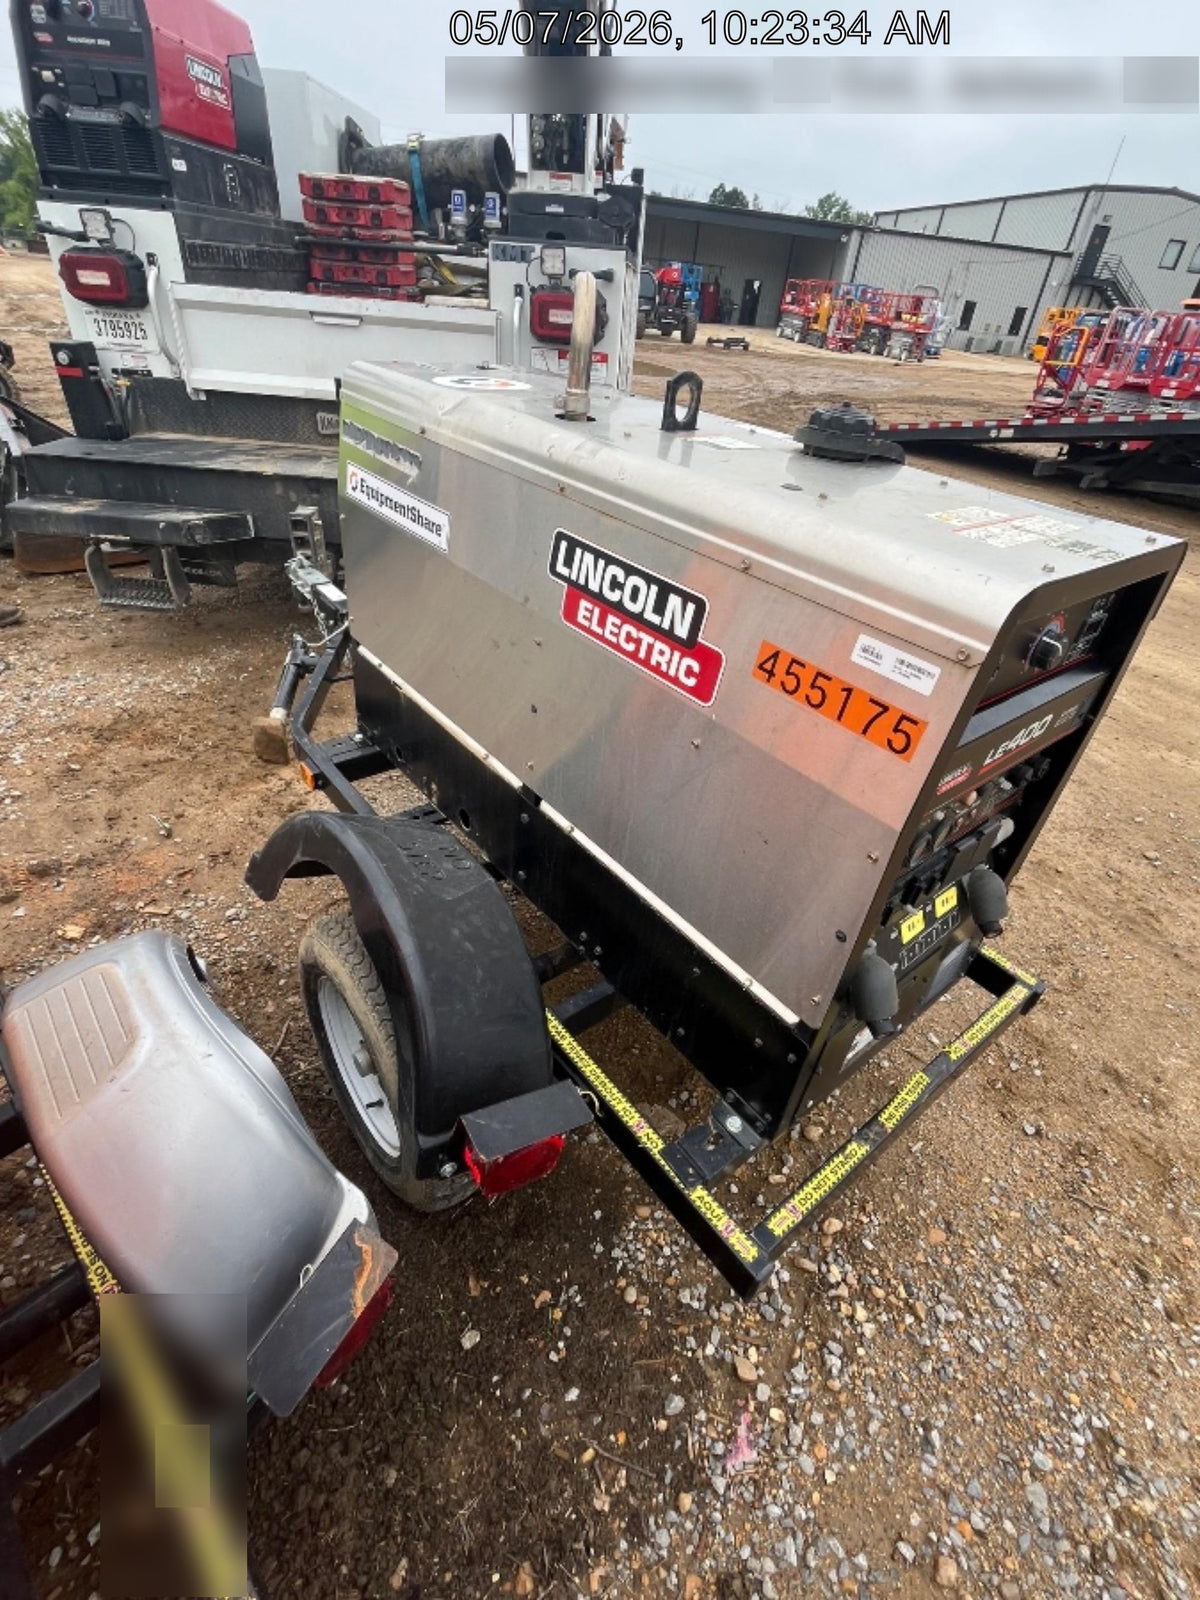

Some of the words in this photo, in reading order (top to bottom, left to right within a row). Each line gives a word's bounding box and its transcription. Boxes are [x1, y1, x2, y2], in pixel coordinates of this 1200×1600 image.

[93, 317, 149, 341] 3795925
[318, 414, 340, 432] KM
[359, 477, 443, 538] EquipmentShare
[555, 539, 697, 640] LINCOLN
[576, 599, 701, 688] ELECTRIC
[756, 649, 921, 756] 455175
[644, 1131, 660, 1149] NO
[798, 1192, 814, 1207] DO
[812, 1174, 831, 1194] NOT
[695, 1195, 723, 1222] AQUI
